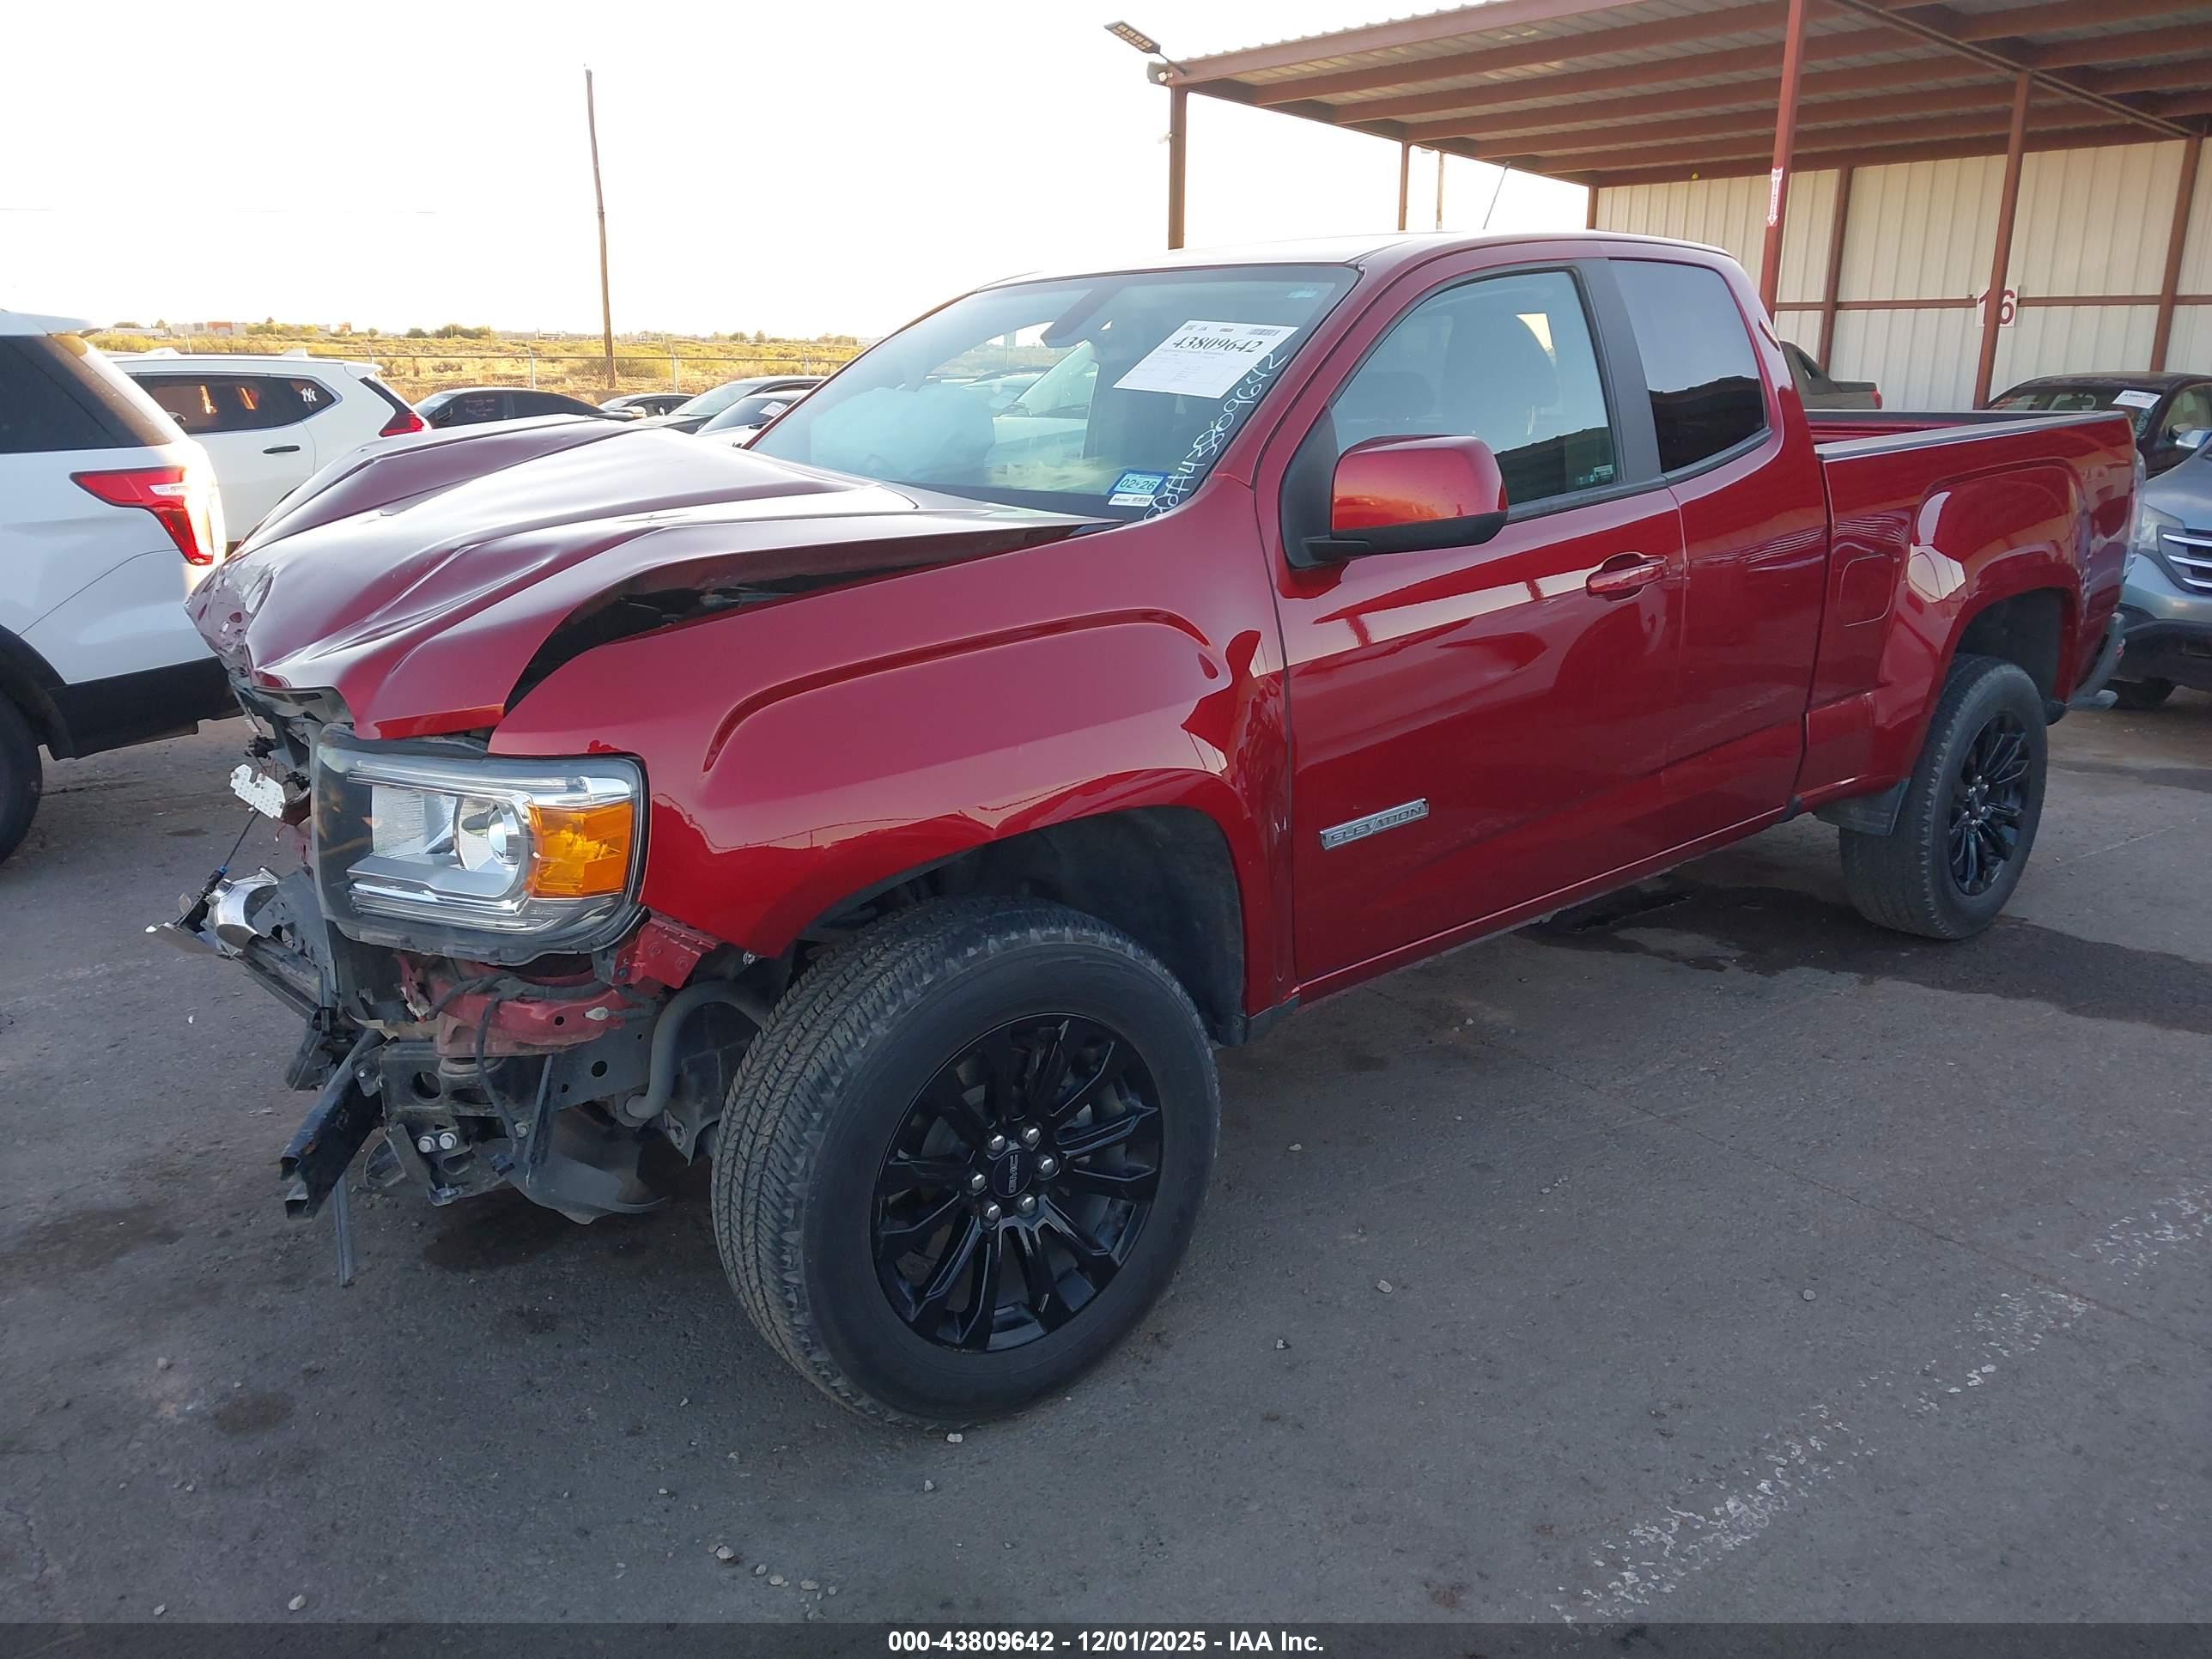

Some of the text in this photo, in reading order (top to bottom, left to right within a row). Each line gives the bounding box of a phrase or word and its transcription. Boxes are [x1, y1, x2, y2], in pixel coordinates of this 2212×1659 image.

[1173, 336, 1264, 353] 43809642
[1331, 805, 1422, 842] ELEVATION
[1008, 1153, 1018, 1194] GMC
